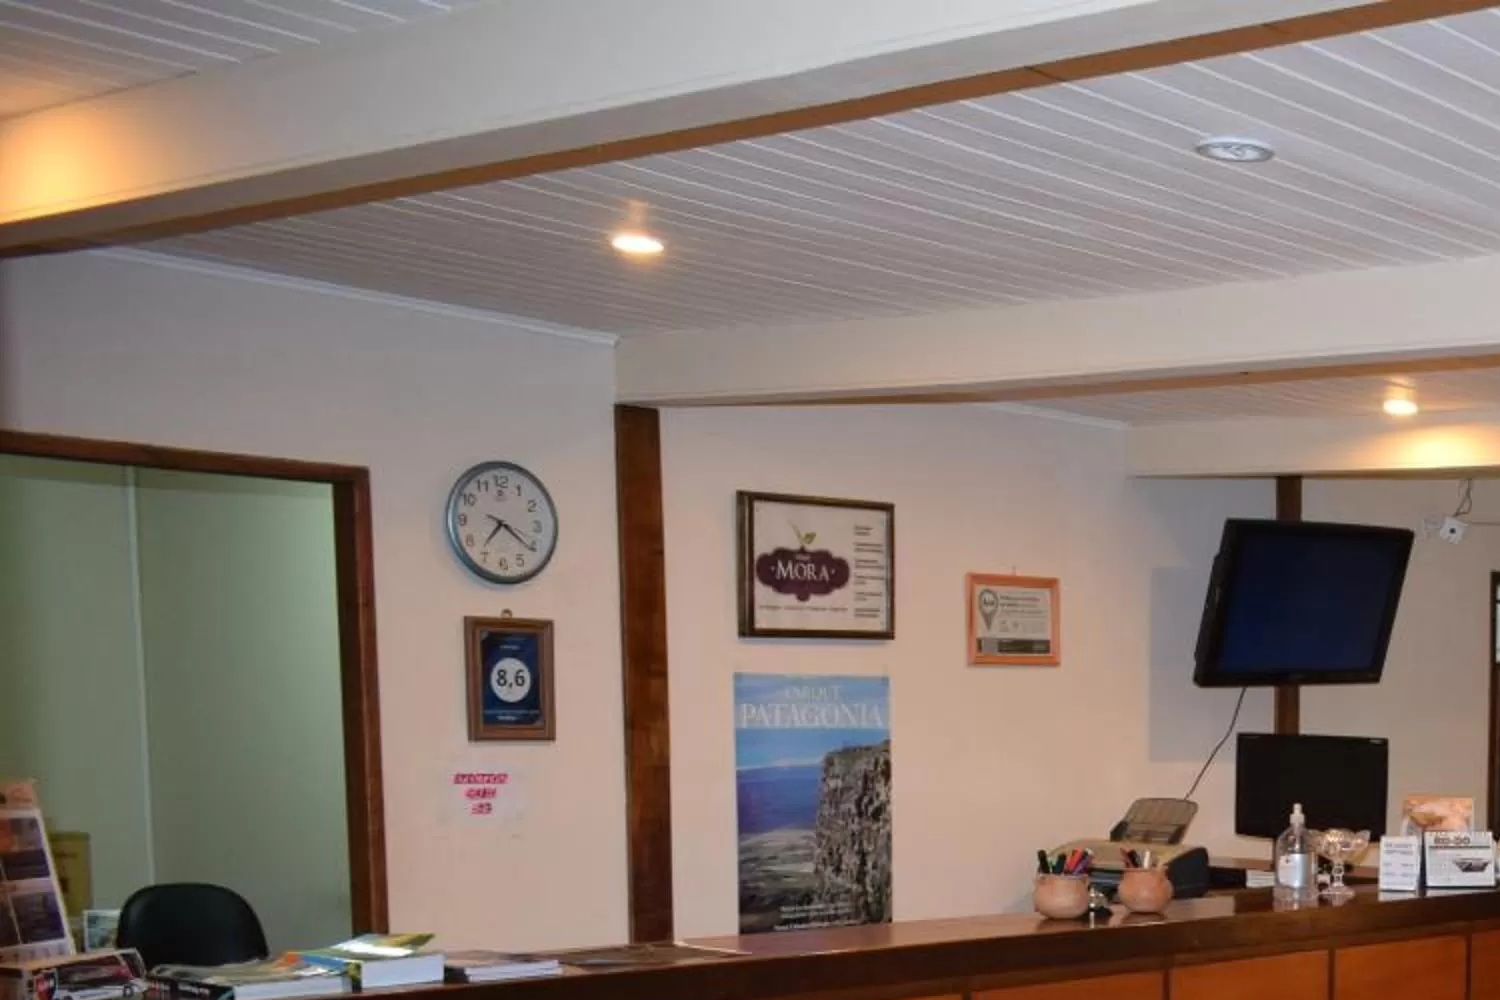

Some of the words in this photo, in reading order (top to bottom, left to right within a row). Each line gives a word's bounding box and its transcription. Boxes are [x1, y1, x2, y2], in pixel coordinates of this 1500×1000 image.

[476, 479, 489, 493] 11
[493, 475, 509, 489] 12
[528, 500, 537, 513] 2
[458, 514, 467, 526] 9
[532, 520, 542, 533] 3
[480, 551, 489, 563] 7
[515, 554, 525, 567] 5
[499, 558, 508, 571] 6
[775, 560, 830, 582] MORA
[496, 669, 526, 689] 8,6
[740, 703, 883, 728] PATAGONIA
